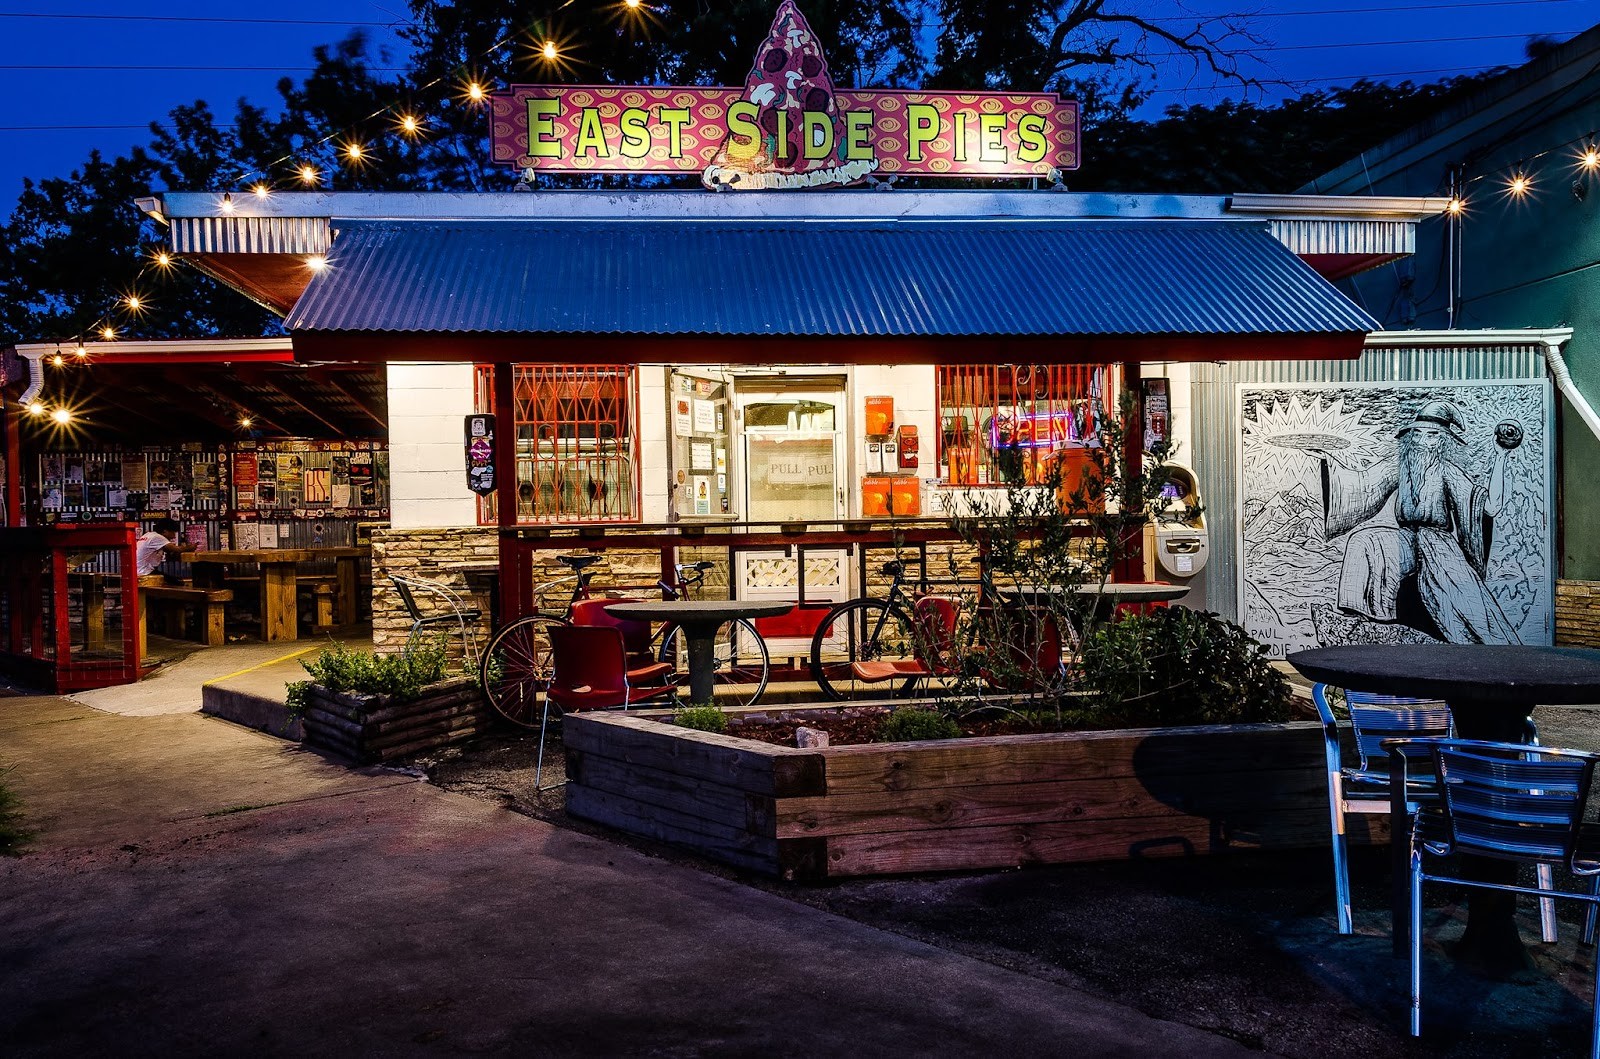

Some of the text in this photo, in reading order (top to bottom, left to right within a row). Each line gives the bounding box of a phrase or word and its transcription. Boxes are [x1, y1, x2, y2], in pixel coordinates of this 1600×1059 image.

[526, 96, 1048, 164] EAST SIDE PIES
[771, 463, 802, 474] PULL
[1251, 628, 1283, 640] PAUL
